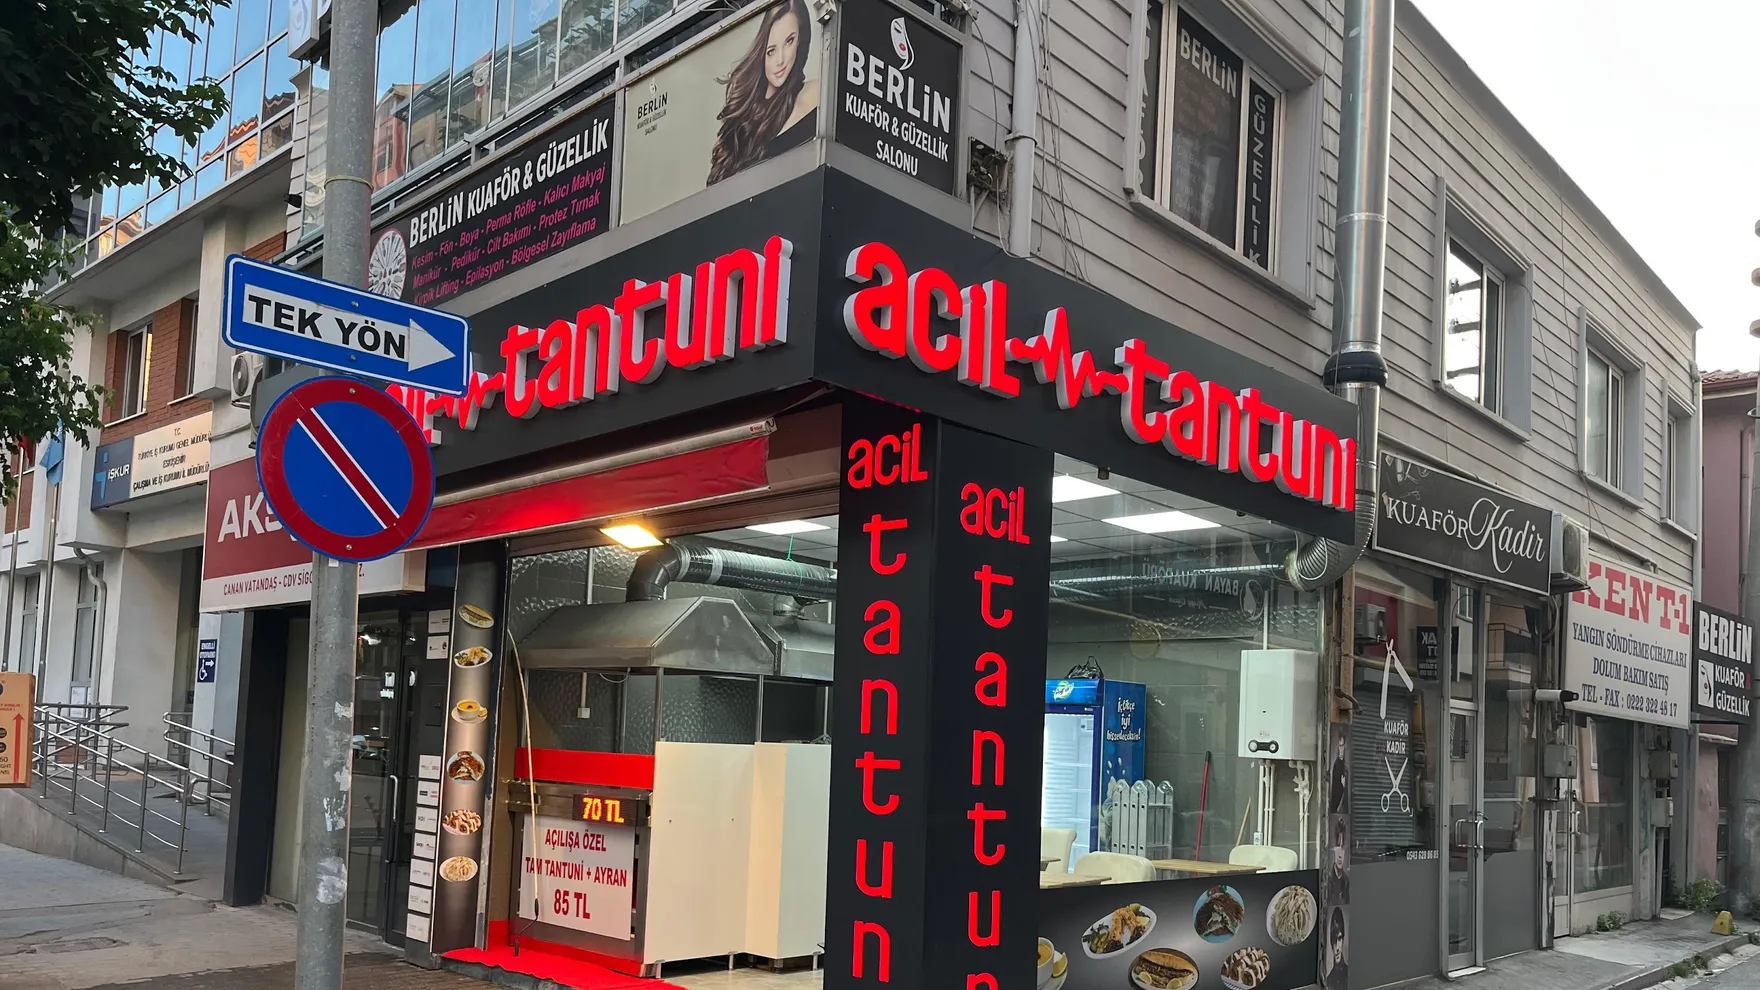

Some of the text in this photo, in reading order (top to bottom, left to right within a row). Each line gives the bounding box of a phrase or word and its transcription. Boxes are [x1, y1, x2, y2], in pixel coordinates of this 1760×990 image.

[845, 92, 948, 163] KUAFÖR & GÜZELLİK
[467, 166, 520, 220] KUAFÖR
[522, 160, 534, 190] &
[536, 118, 610, 183] GÜZELLİK
[876, 139, 918, 176] SALONU
[412, 250, 434, 269] Kesim
[439, 241, 454, 256] Fön
[460, 228, 479, 247] Boya
[486, 211, 512, 234] Perma
[513, 199, 537, 220] Röfle
[543, 184, 570, 206] Kalıcı
[571, 162, 606, 193] Makyaj
[413, 265, 441, 289] Manikür
[451, 247, 481, 271] Pedikür
[487, 236, 501, 255] Cilt
[502, 224, 531, 247] Bakımı
[538, 207, 568, 231] Protez
[571, 189, 601, 216] Tırnak
[413, 287, 434, 306] Kirpik
[435, 279, 459, 299] Lifting
[465, 258, 505, 286] Epilasyon
[511, 234, 549, 266] Bölgesel
[551, 217, 597, 248] Zayıflama
[248, 294, 406, 360] TEK YÖN
[500, 234, 792, 419] tantuni
[1115, 338, 1356, 513] tantuni
[1387, 497, 1546, 574] KUAFÖR Kadir
[223, 583, 243, 596] CANAN
[244, 576, 277, 593] VATANDAŞ
[283, 573, 296, 588] CDV
[1572, 622, 1688, 668] YANGIN SÖNDÜRME CİHAZLARI
[1592, 657, 1669, 696] DOLUM BAKIM SATIŞ
[1715, 664, 1745, 689] KUAFÖR
[1582, 683, 1598, 703] TEL
[1604, 688, 1620, 708] FAX
[1626, 693, 1644, 712] 0222
[1645, 697, 1658, 714] 322
[1669, 702, 1678, 717] 17
[1715, 690, 1750, 717] GÜZELLİK
[1383, 720, 1409, 736] KUAFÖR
[1386, 738, 1406, 754] KADİR
[582, 796, 625, 824] 70 TL
[545, 828, 607, 852] AÇILIŞA ÖZEL
[525, 857, 627, 888] TAM TANTUNİ + AYRAN
[553, 888, 591, 919] 85 TL
